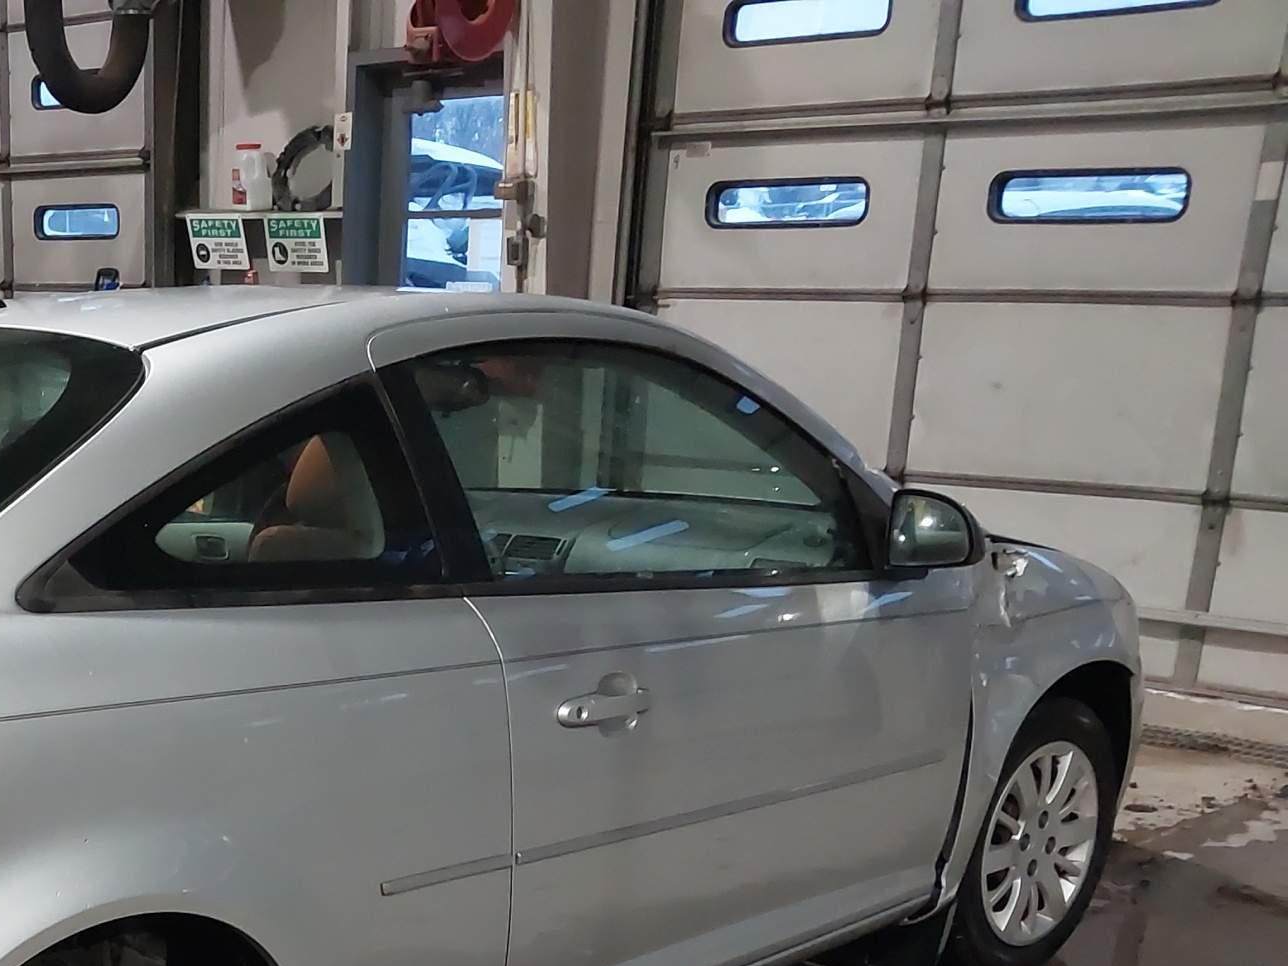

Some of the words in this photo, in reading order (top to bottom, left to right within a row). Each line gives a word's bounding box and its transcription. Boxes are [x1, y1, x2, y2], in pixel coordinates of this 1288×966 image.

[192, 219, 236, 232] SAFETY
[270, 219, 318, 232] SAFETY
[201, 229, 232, 237] FIRST
[279, 229, 312, 237] FIRST
